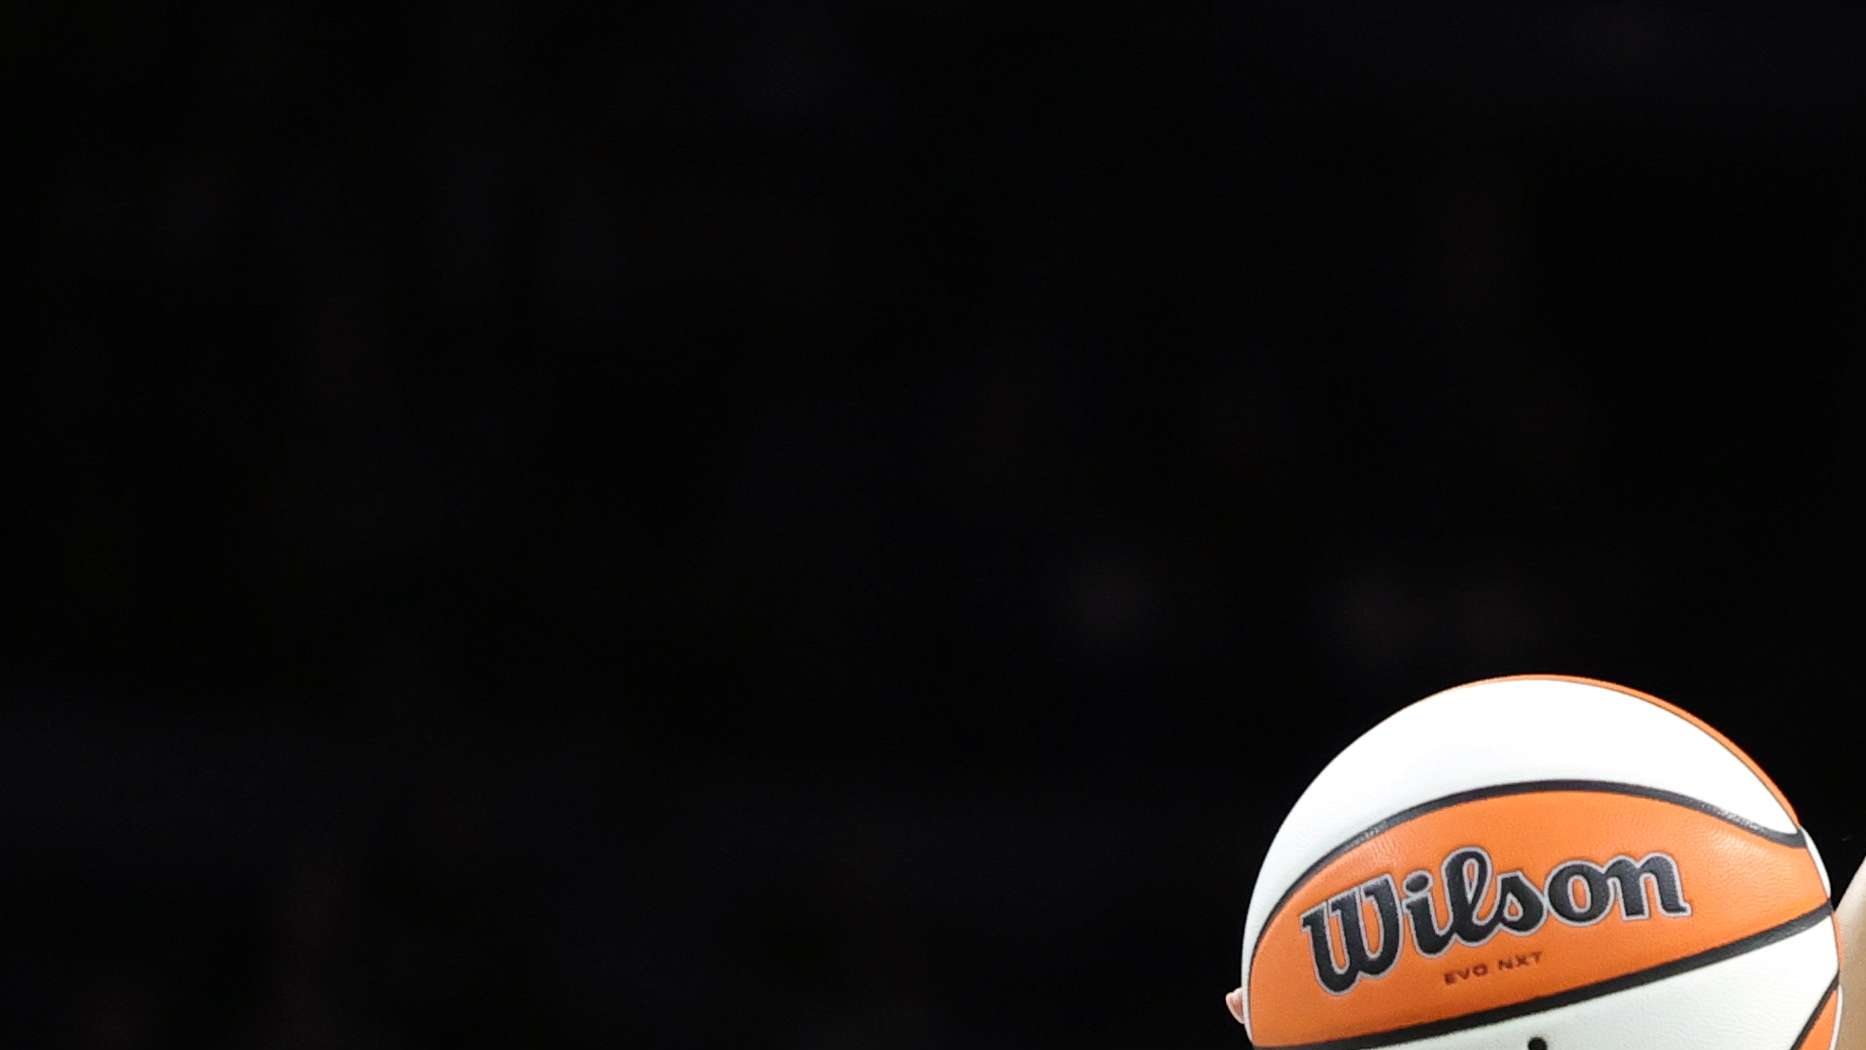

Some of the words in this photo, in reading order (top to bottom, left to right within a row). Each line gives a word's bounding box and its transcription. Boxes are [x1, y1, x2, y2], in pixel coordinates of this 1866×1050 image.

[1300, 845, 1694, 994] Wilson
[1444, 963, 1488, 985] EVO
[1498, 951, 1543, 971] NXT
